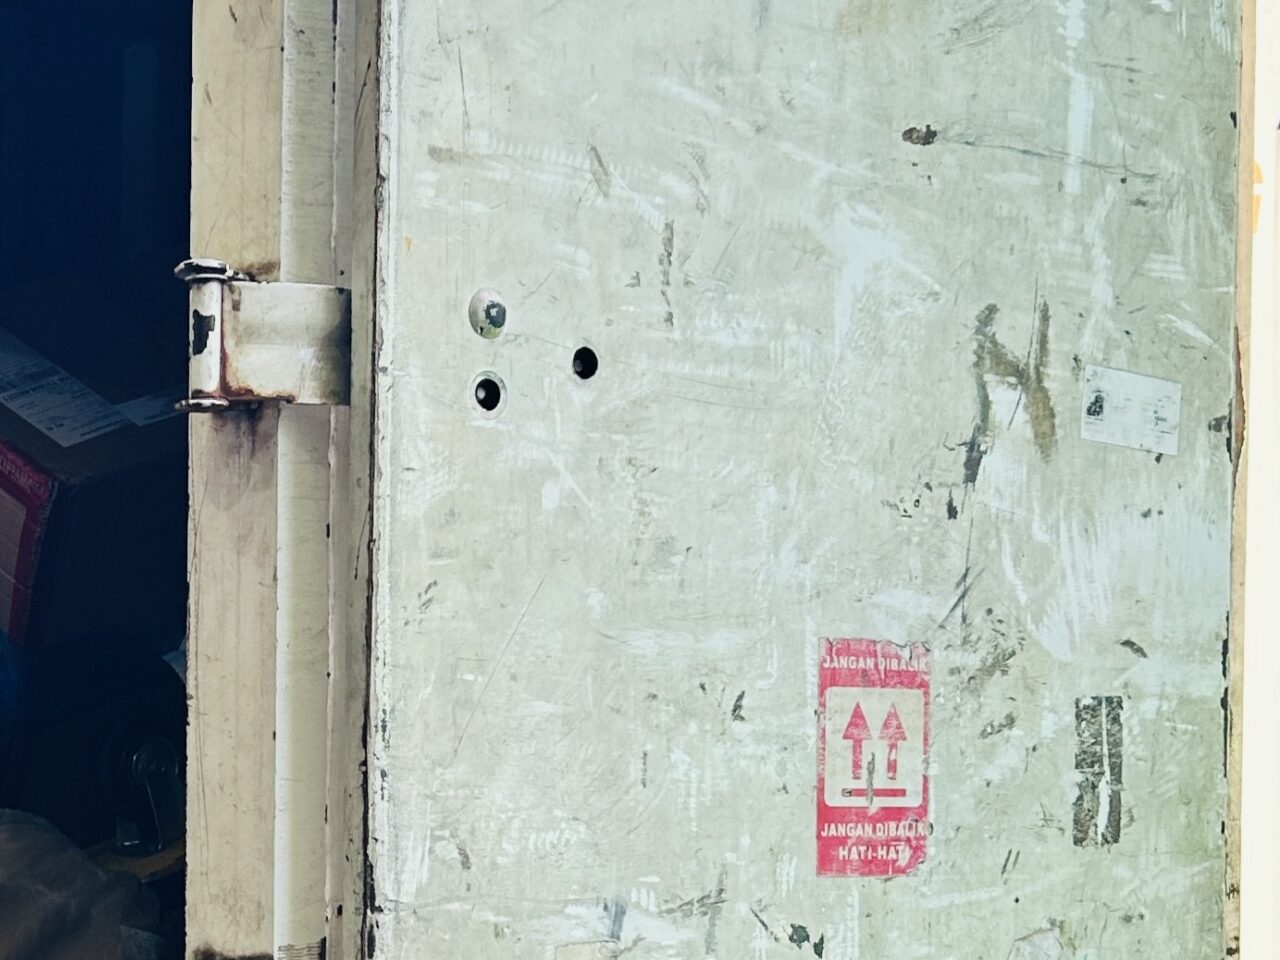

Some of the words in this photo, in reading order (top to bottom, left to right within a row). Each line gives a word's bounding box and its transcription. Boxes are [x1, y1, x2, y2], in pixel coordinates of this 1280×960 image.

[822, 654, 875, 670] JANGAN
[820, 822, 873, 838] JANGAN
[875, 820, 926, 839] DIBALIK
[838, 844, 911, 861] HATI-HATI
